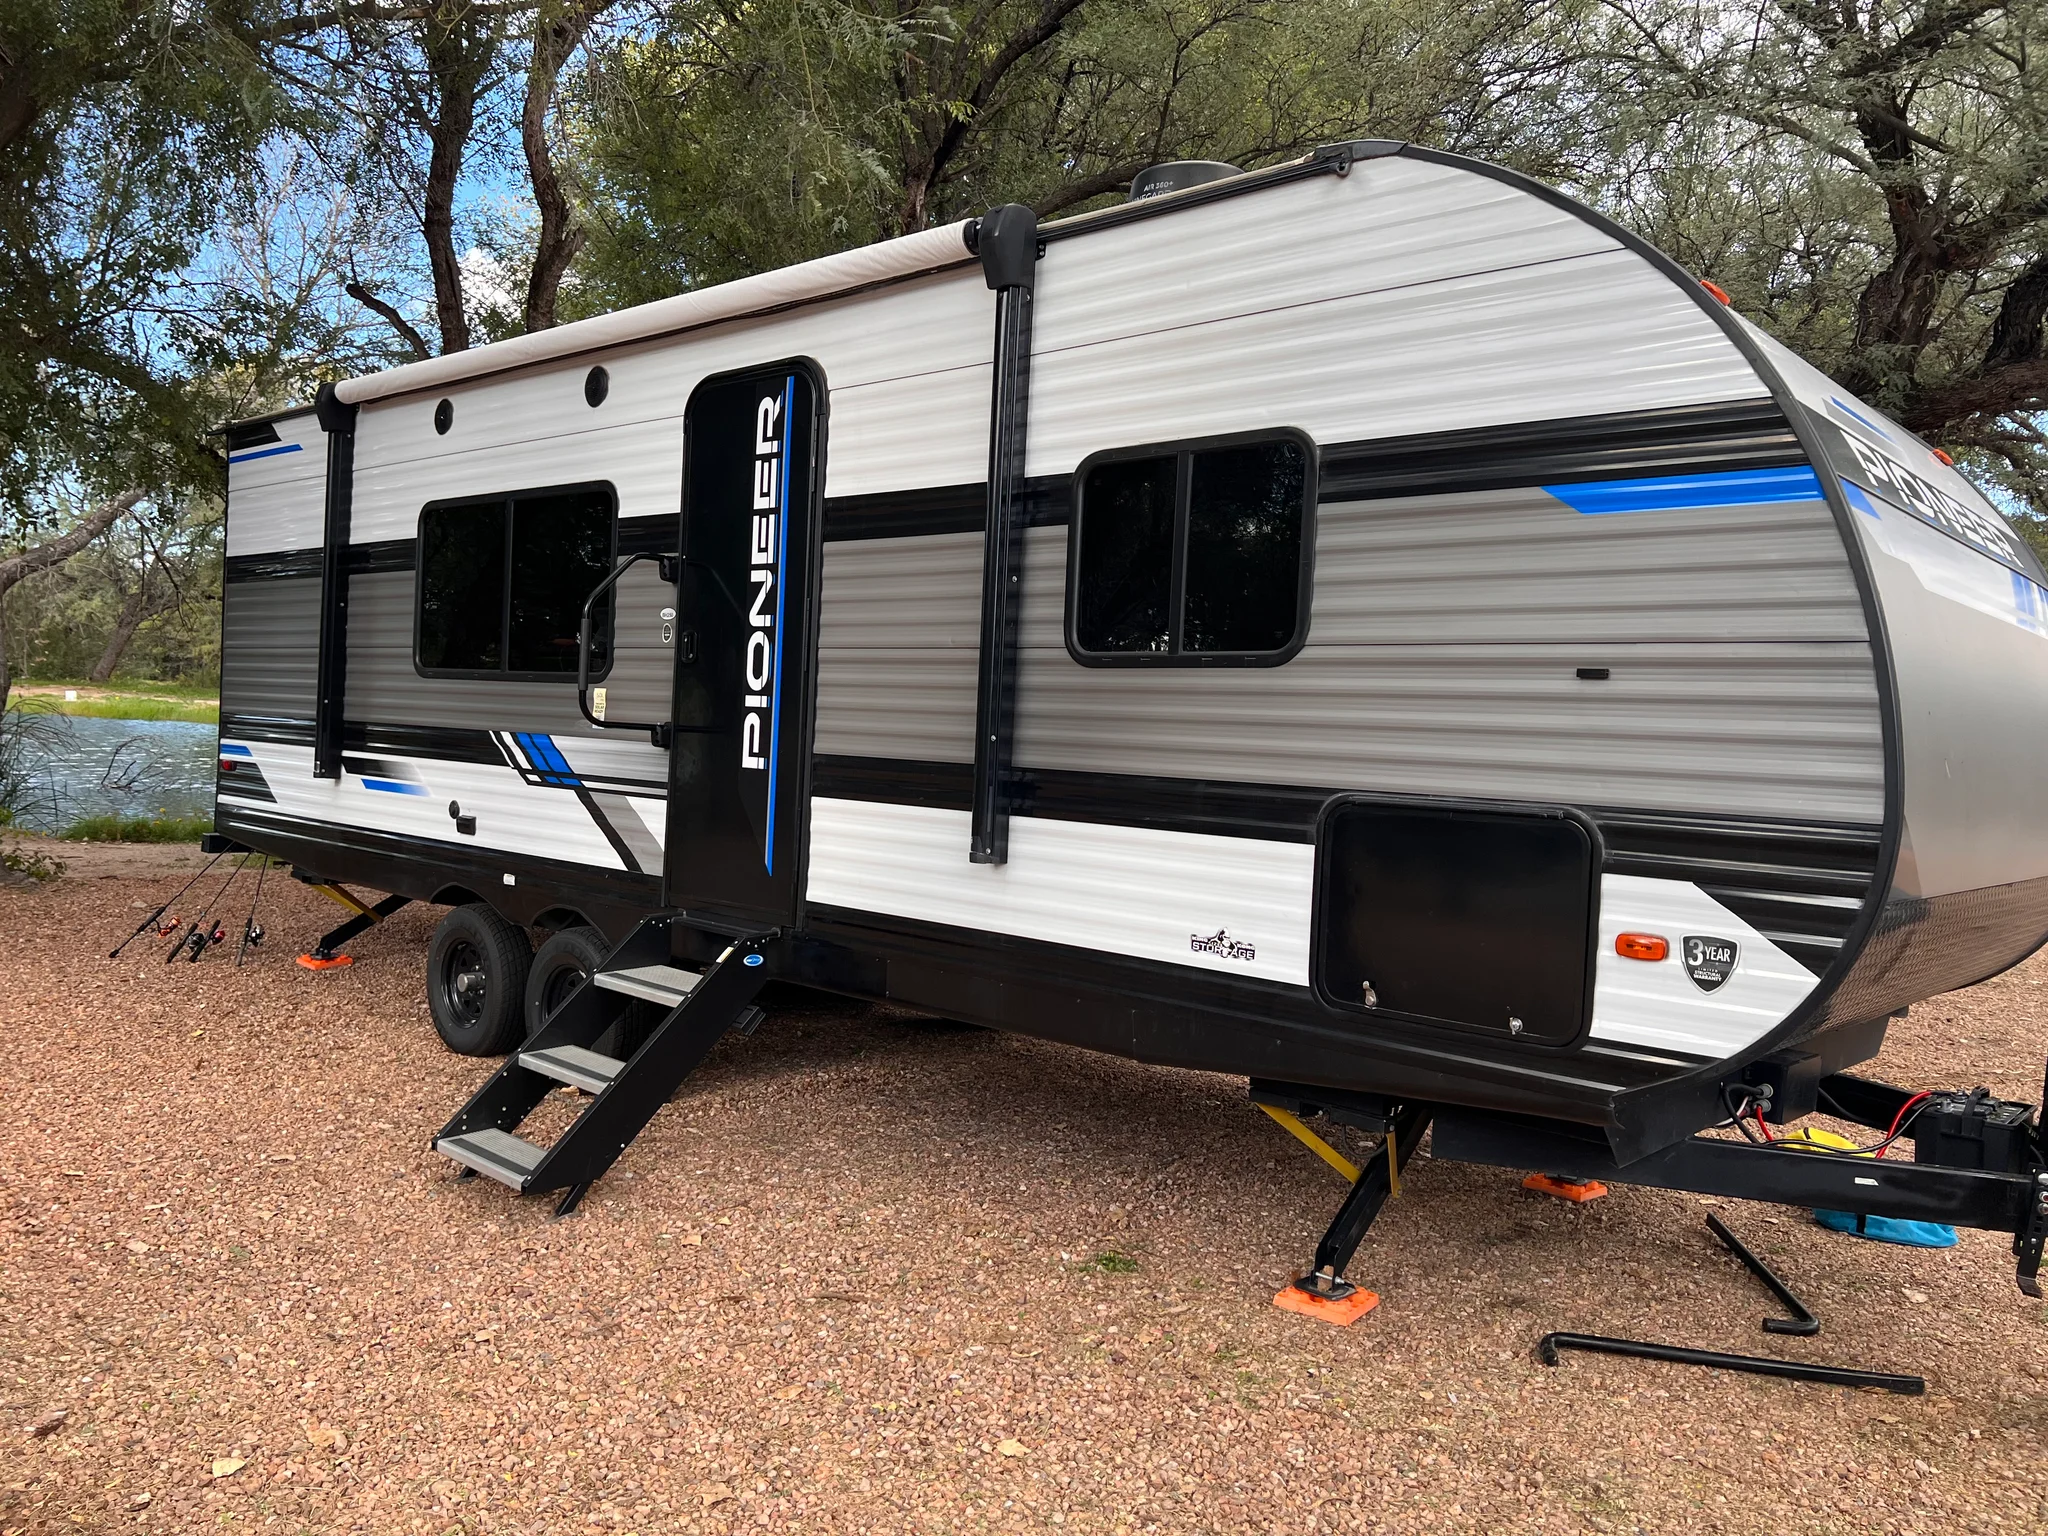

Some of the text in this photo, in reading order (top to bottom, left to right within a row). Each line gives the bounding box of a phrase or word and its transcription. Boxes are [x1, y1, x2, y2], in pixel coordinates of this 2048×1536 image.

[1143, 183, 1155, 192] AIR
[1840, 429, 2026, 569] PIONEER
[741, 395, 782, 771] PIONEER
[1687, 938, 1731, 966] 3 YEAR
